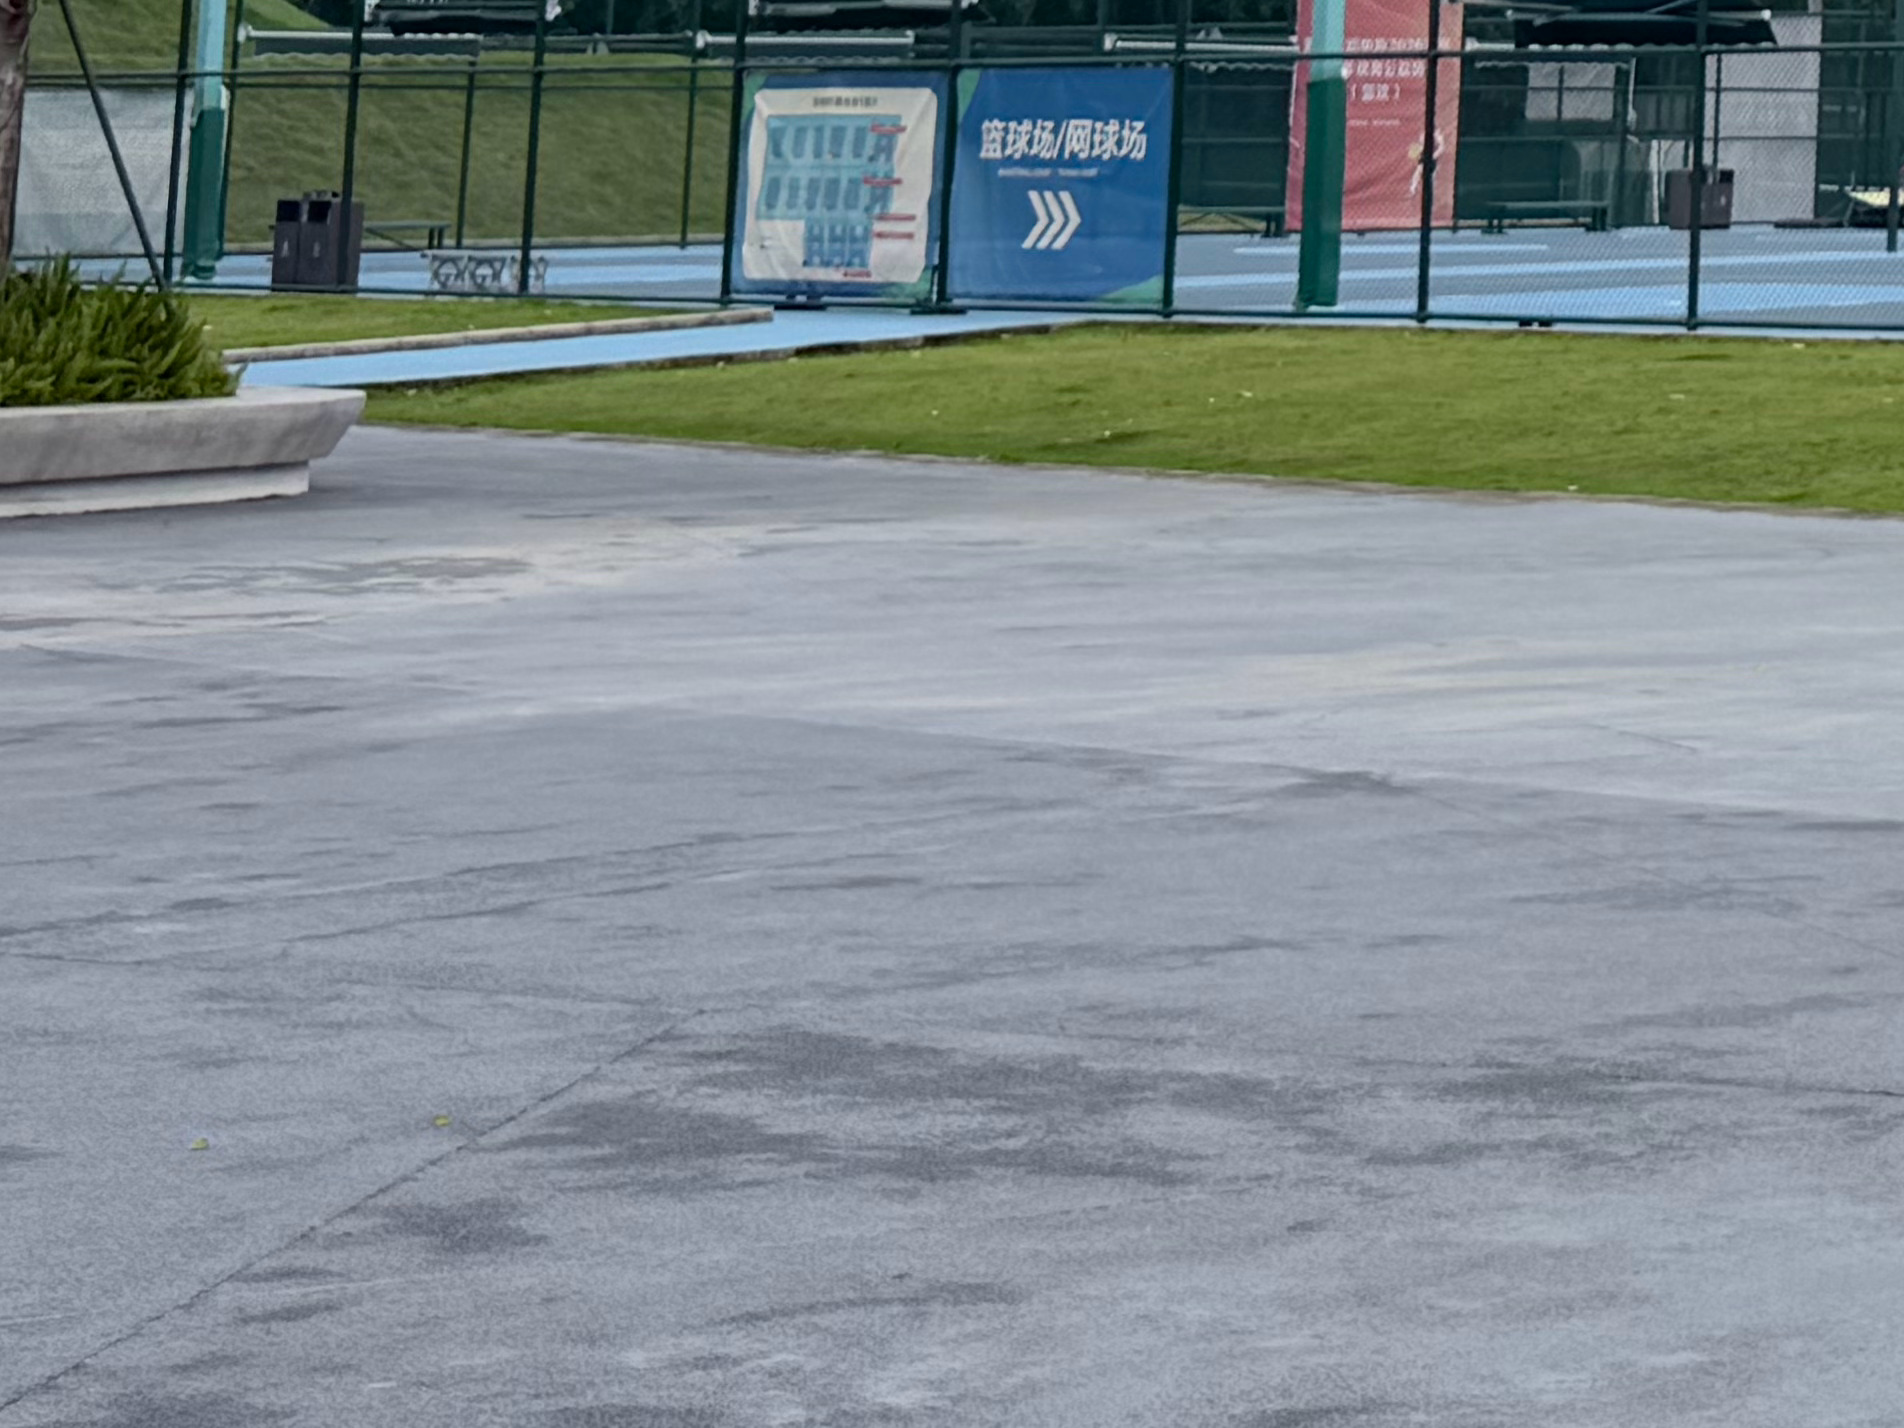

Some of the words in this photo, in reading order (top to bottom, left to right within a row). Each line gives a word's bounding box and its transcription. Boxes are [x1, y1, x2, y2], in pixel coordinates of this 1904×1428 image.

[979, 119, 1148, 162] 篮球场/网球场
